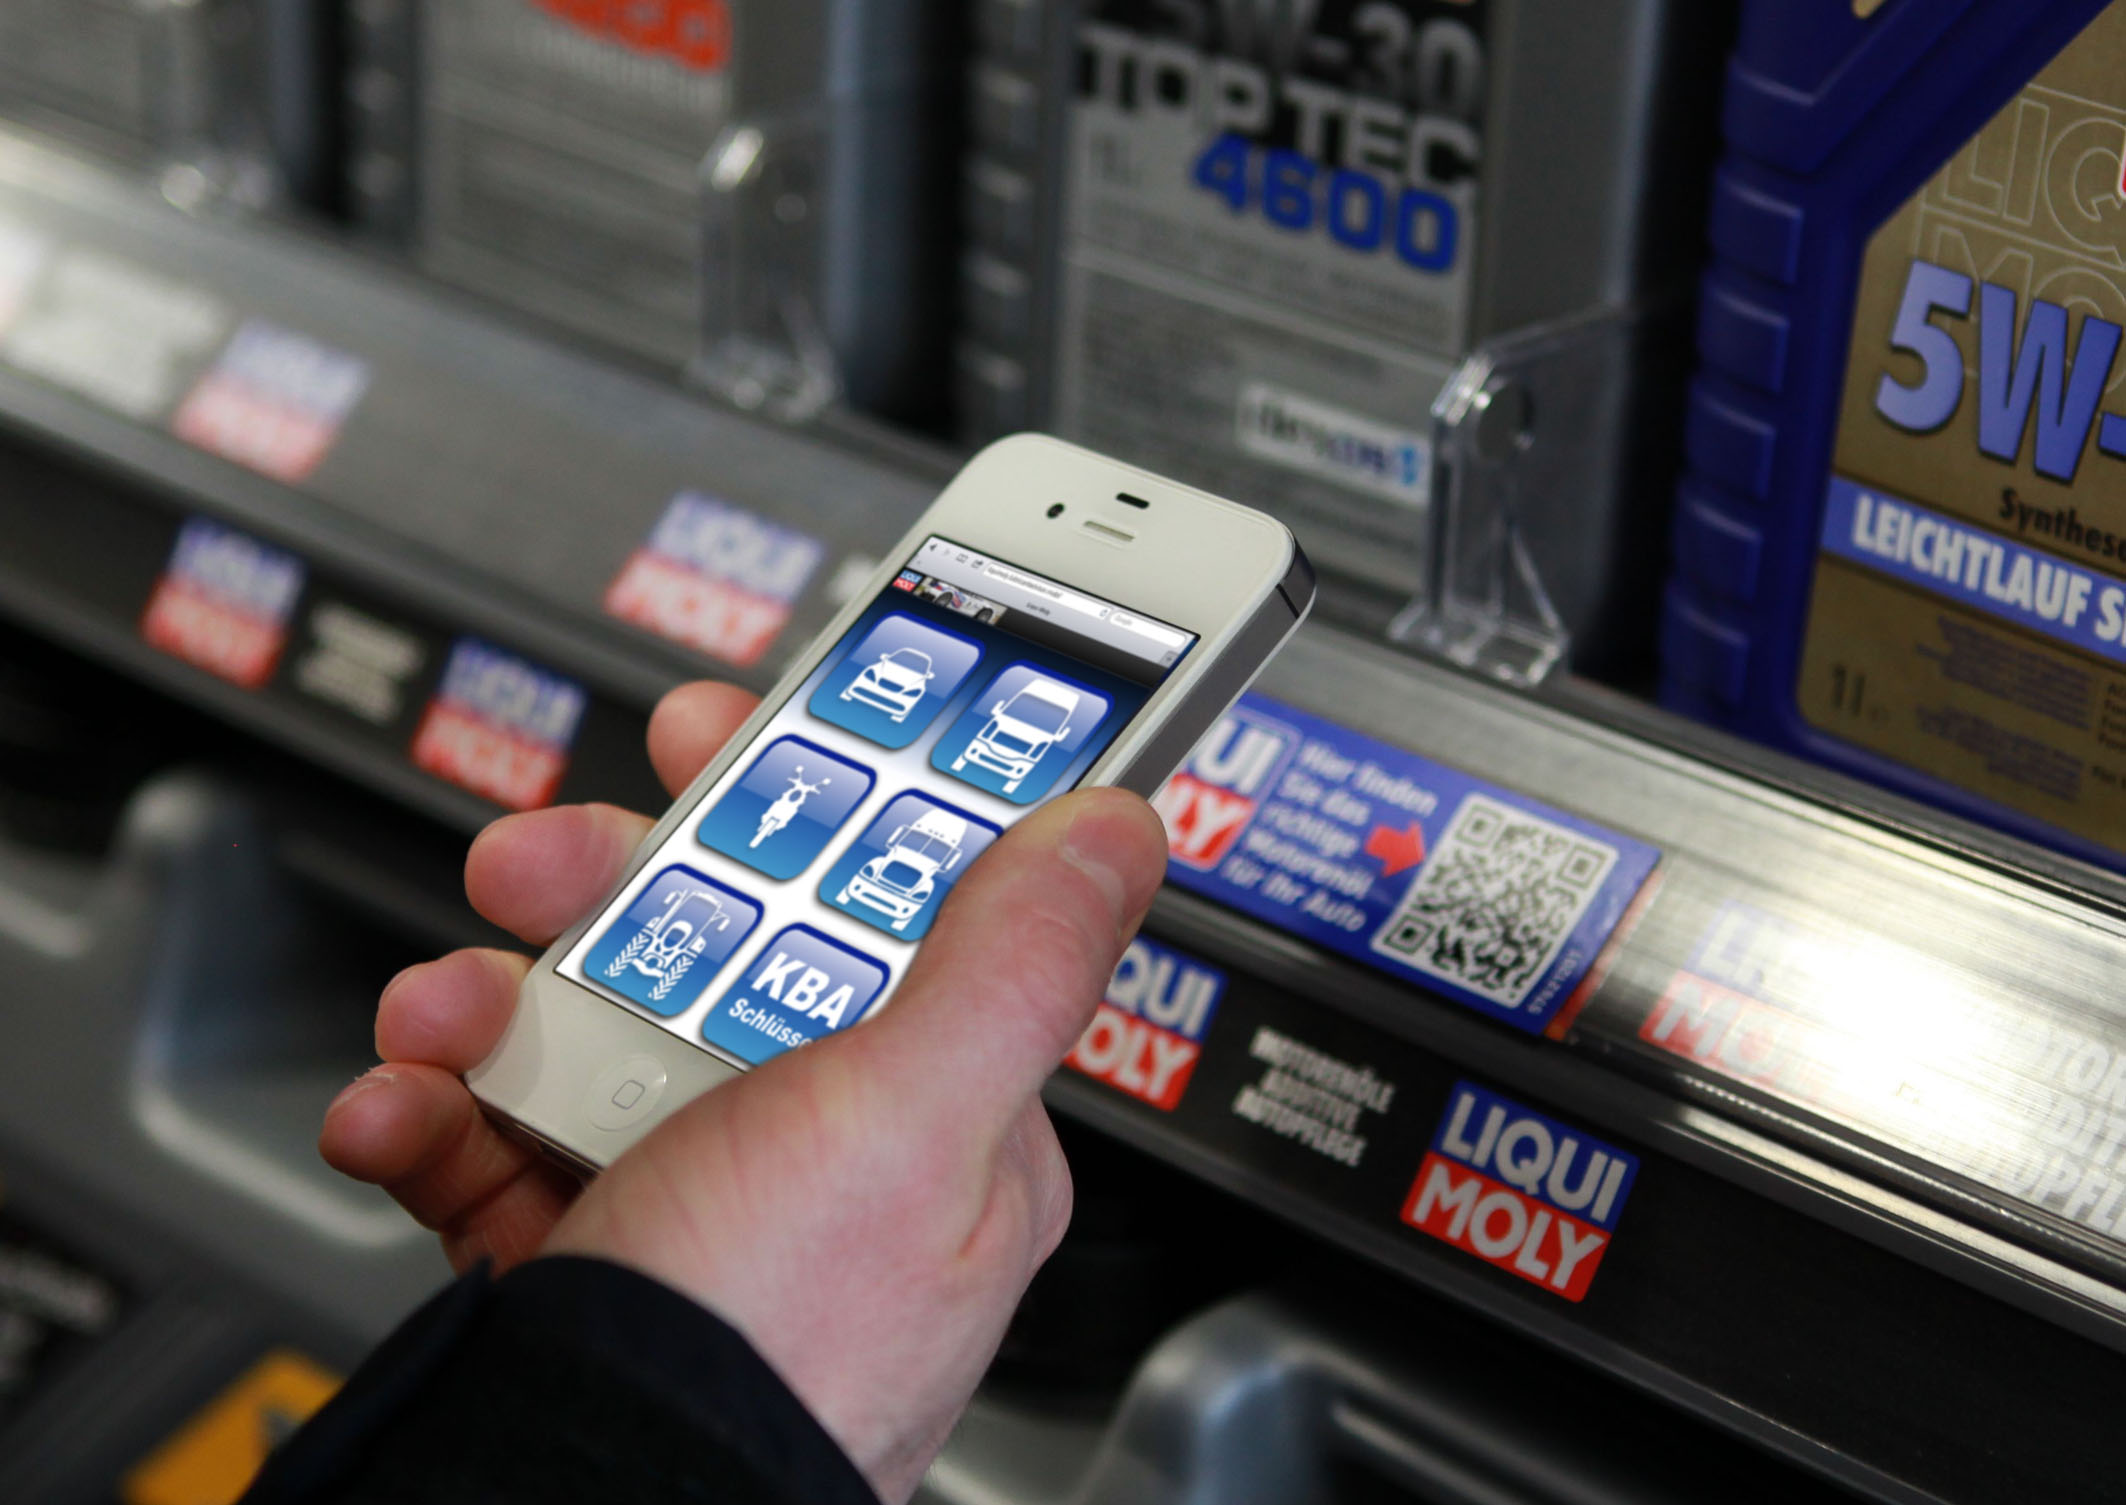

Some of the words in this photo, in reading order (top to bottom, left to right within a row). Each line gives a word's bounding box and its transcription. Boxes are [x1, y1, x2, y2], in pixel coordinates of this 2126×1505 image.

[1283, 78, 1479, 190] TEC
[1192, 132, 1458, 273] 4600
[1851, 494, 2093, 628] LEICHTLAUF
[2094, 585, 2126, 649] S
[1279, 769, 1323, 807] Sie
[1321, 789, 1371, 827] das
[1301, 743, 1356, 782] Hier
[1356, 762, 1438, 818] finden
[1262, 801, 1359, 858] richtige
[1221, 855, 1265, 888] für
[1261, 872, 1307, 905] Ihr
[1302, 890, 1366, 932] Auto
[752, 952, 855, 1030] KBA
[1104, 939, 1218, 1038] QUI
[1079, 1009, 1197, 1100] OLY
[1441, 1092, 1628, 1223] LIQUI
[1411, 1162, 1606, 1291] MOLY
